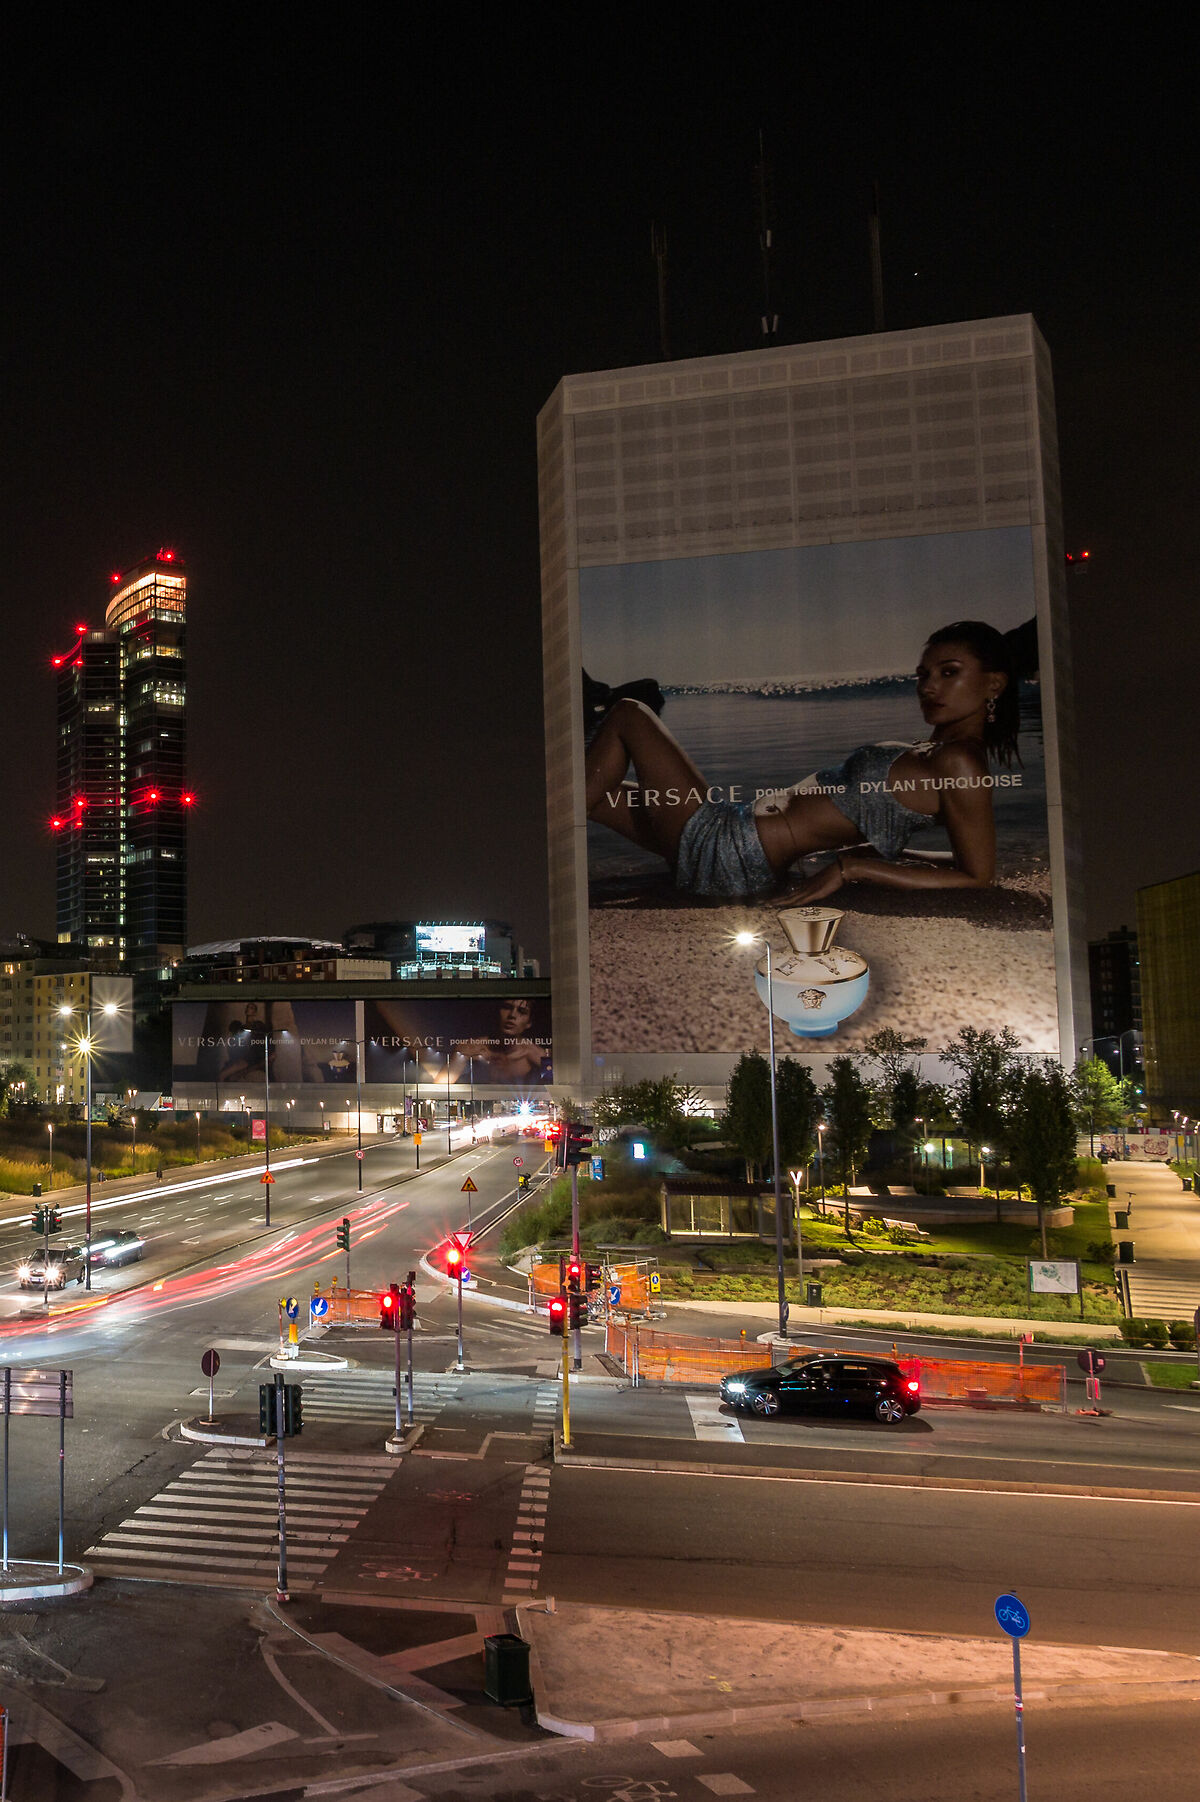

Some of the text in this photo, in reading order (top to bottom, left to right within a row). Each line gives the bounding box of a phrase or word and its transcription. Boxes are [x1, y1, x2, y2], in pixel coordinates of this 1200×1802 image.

[606, 774, 1023, 808] VERSACE pour femme DYLAN TURQUOISE
[178, 1036, 245, 1047] VERSACE
[250, 1039, 268, 1047] pou
[300, 1037, 327, 1045] DYLAN
[370, 1036, 445, 1047] VERSACE
[450, 1038, 469, 1046] pour
[470, 1037, 500, 1046] homme
[504, 1037, 533, 1046] DYLAN
